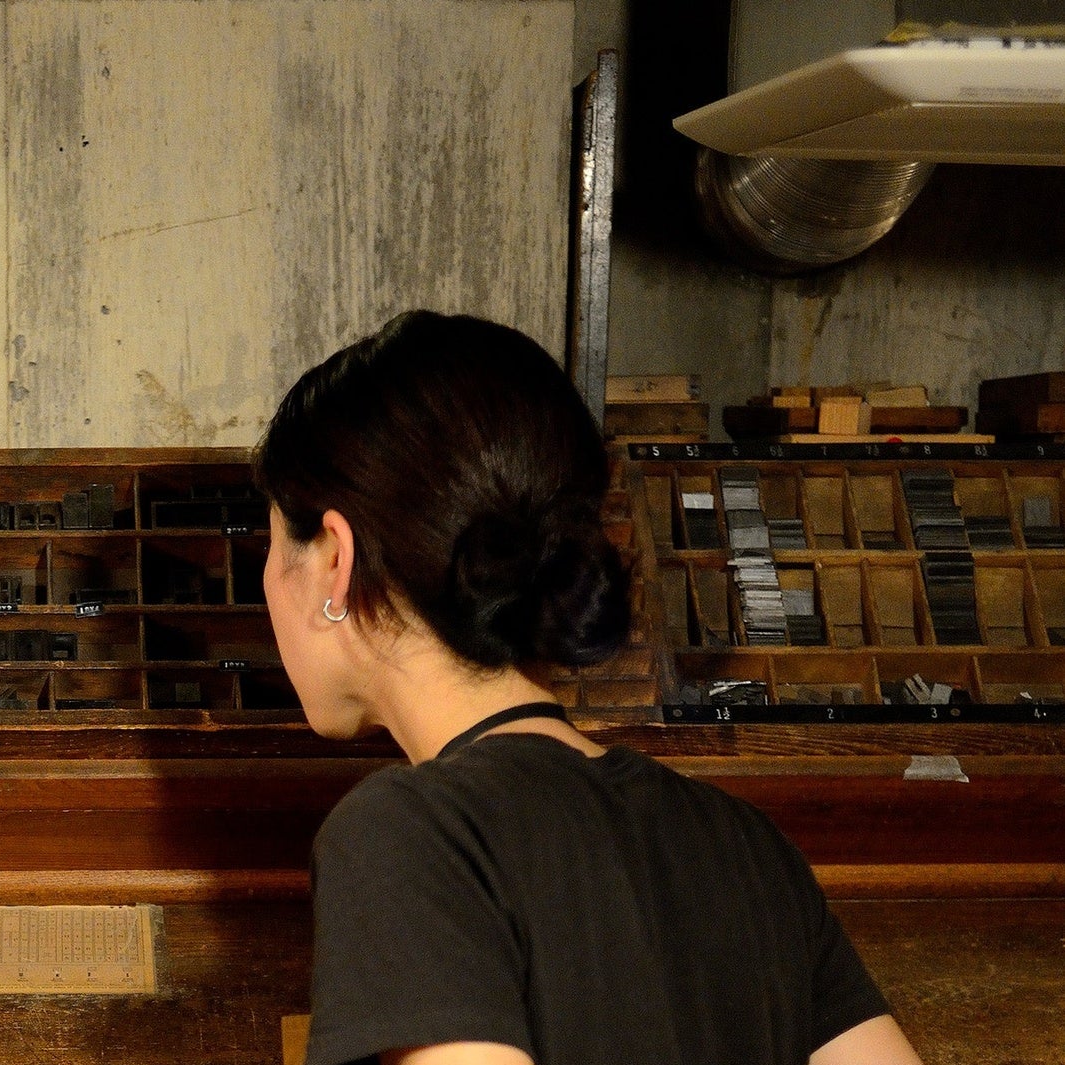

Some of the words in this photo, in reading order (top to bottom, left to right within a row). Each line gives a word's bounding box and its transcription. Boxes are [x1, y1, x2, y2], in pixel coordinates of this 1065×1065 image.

[653, 446, 660, 457] 5
[924, 446, 931, 456] 8
[826, 708, 834, 719] 2
[930, 707, 938, 719] 3
